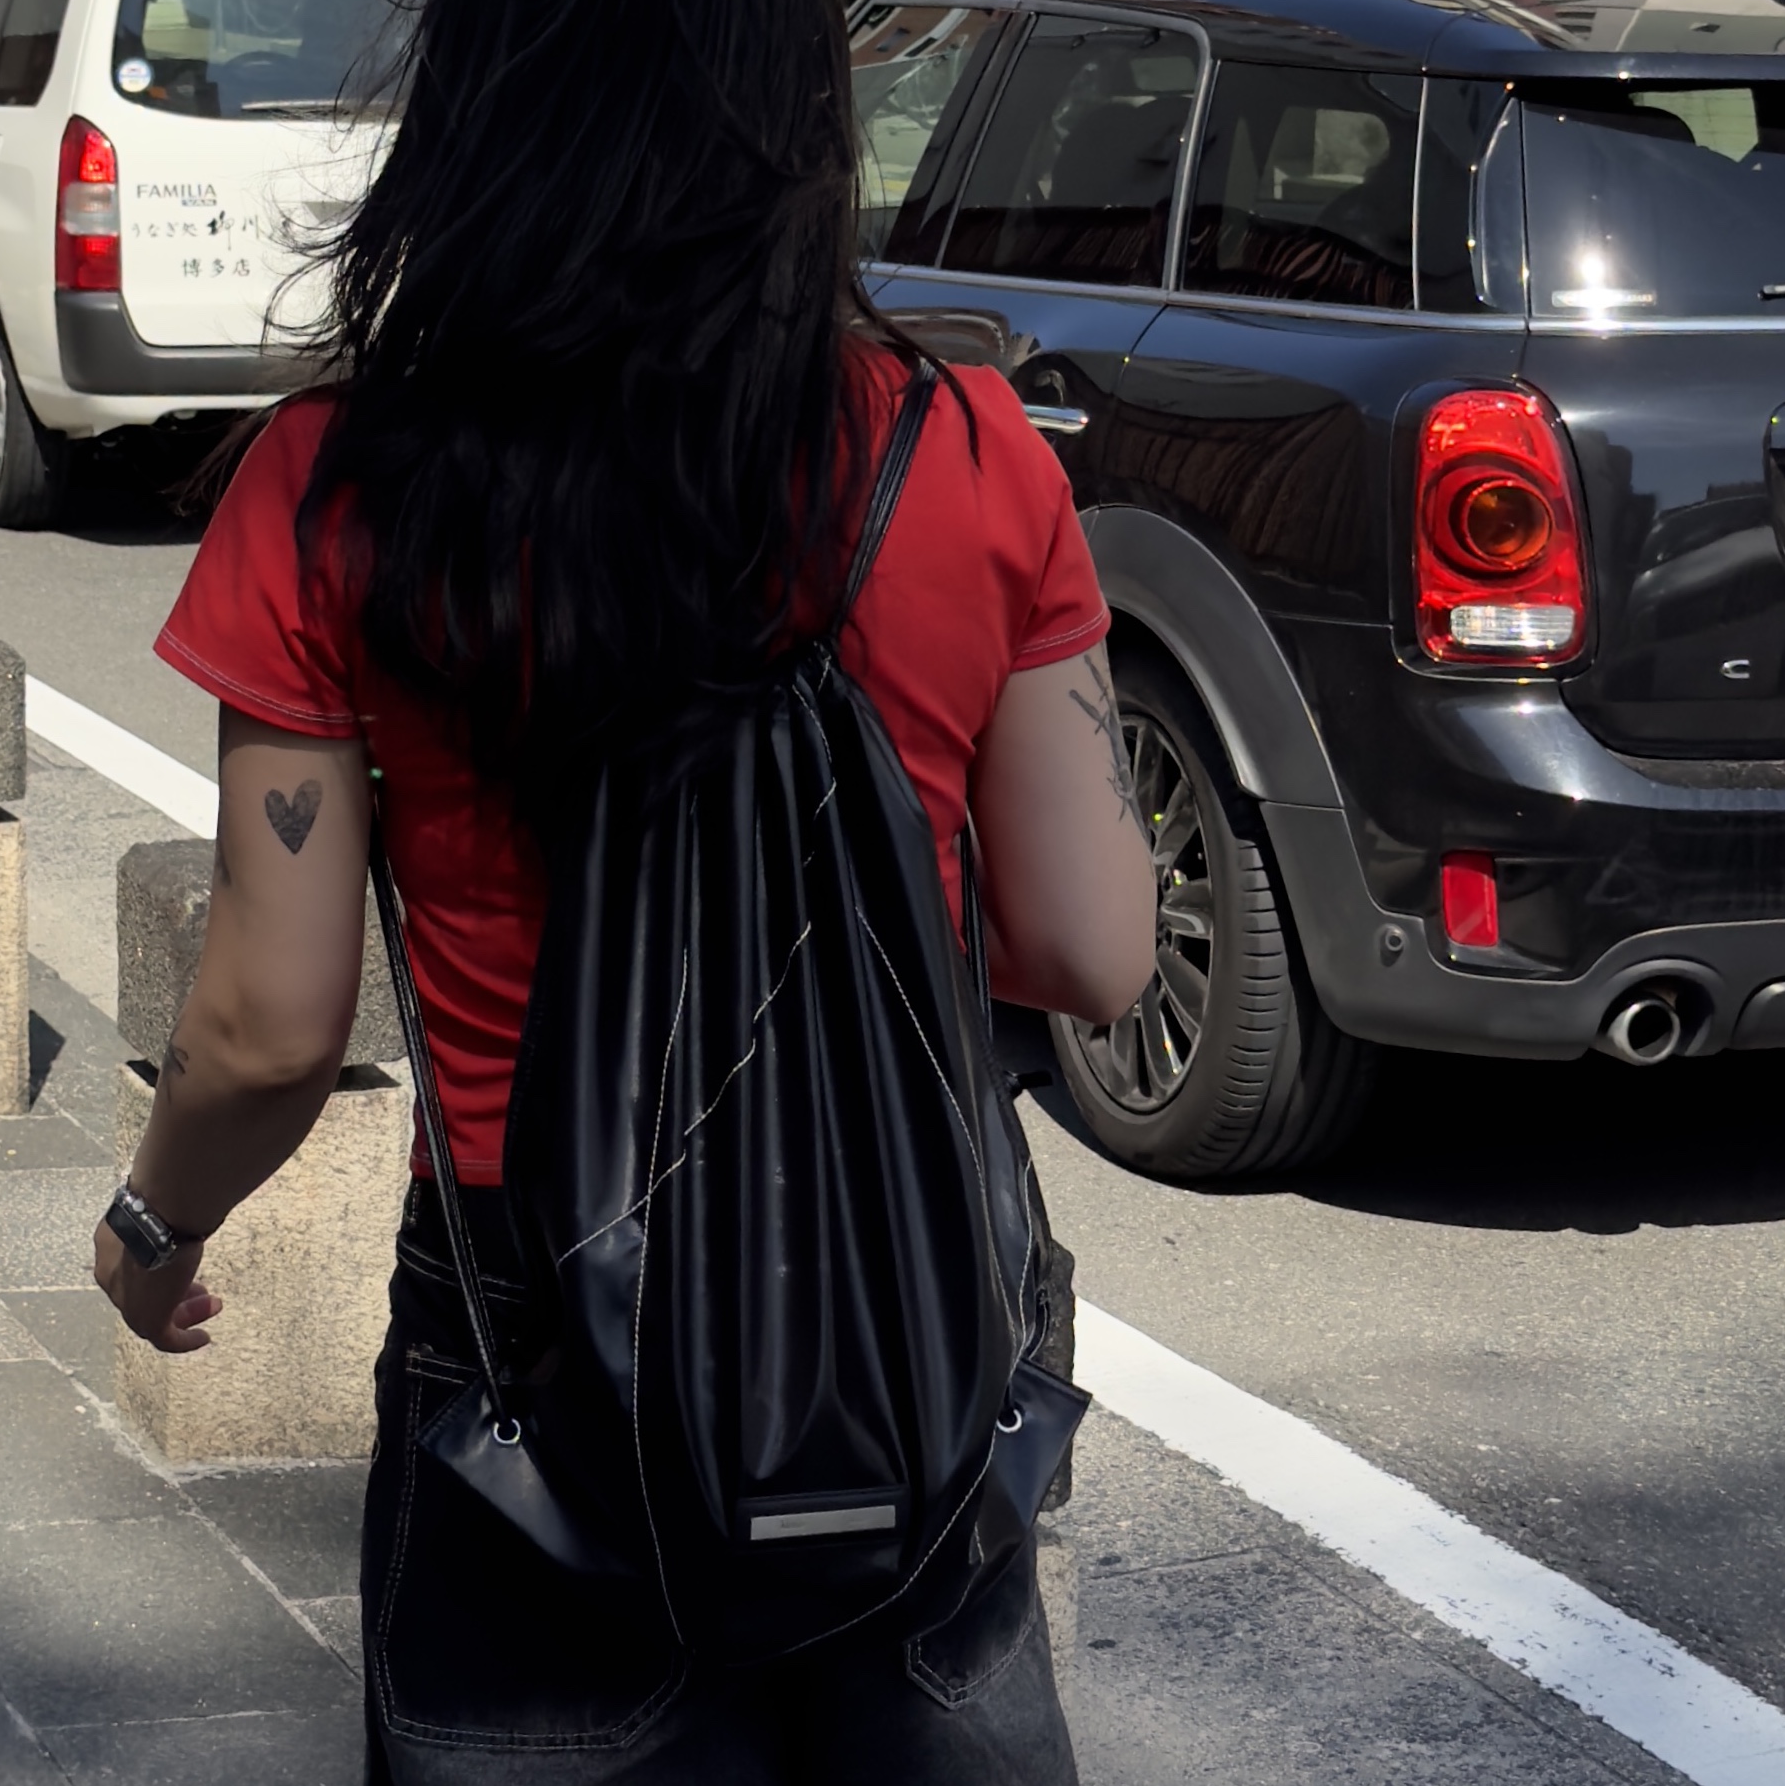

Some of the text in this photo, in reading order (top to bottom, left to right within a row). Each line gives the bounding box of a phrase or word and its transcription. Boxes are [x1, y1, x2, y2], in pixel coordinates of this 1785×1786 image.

[136, 184, 218, 199] FAMILIA
[182, 258, 251, 278] 博多店
